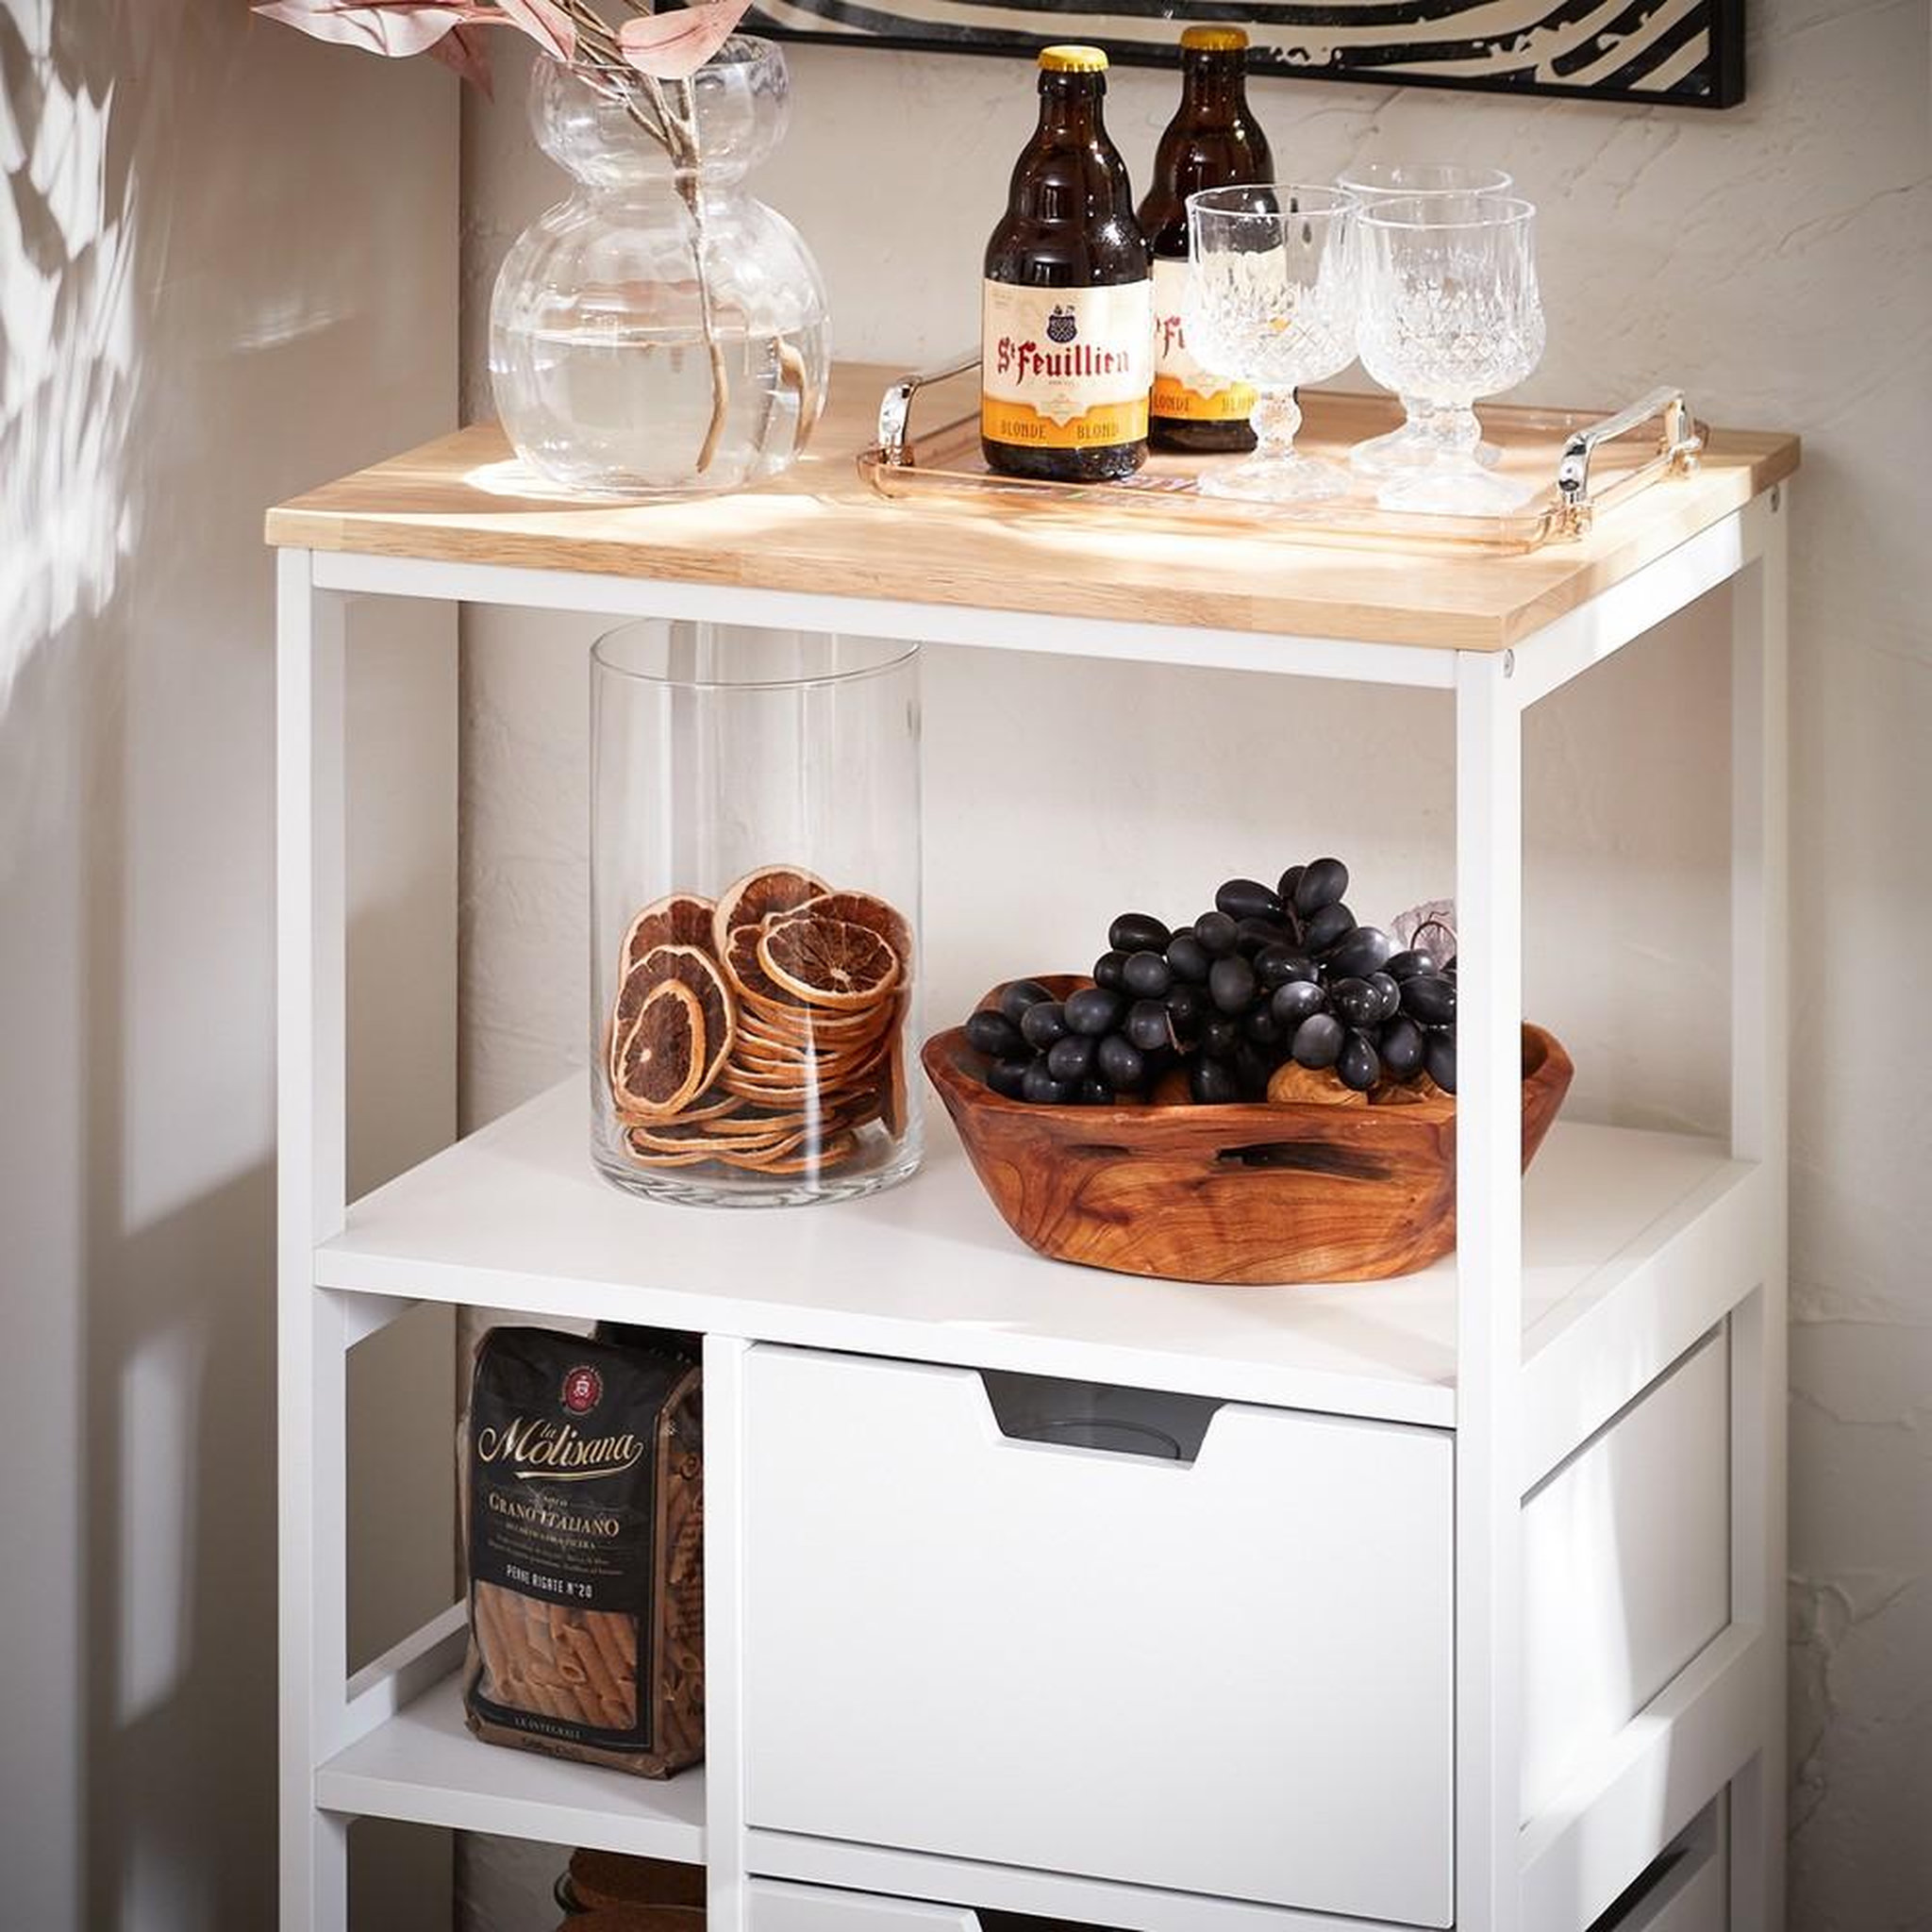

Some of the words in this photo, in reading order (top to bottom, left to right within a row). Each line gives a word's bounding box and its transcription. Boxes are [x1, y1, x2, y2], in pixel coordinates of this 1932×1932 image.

[1016, 340, 1129, 386] Feuillien
[1155, 393, 1190, 411] LONDE
[1000, 419, 1047, 440] BLONDE
[478, 1416, 643, 1468] Molisana
[489, 1491, 536, 1523] GRANO
[539, 1508, 620, 1538] ITALIANO
[506, 1563, 530, 1585] PENNE
[532, 1573, 564, 1594] RIGATE
